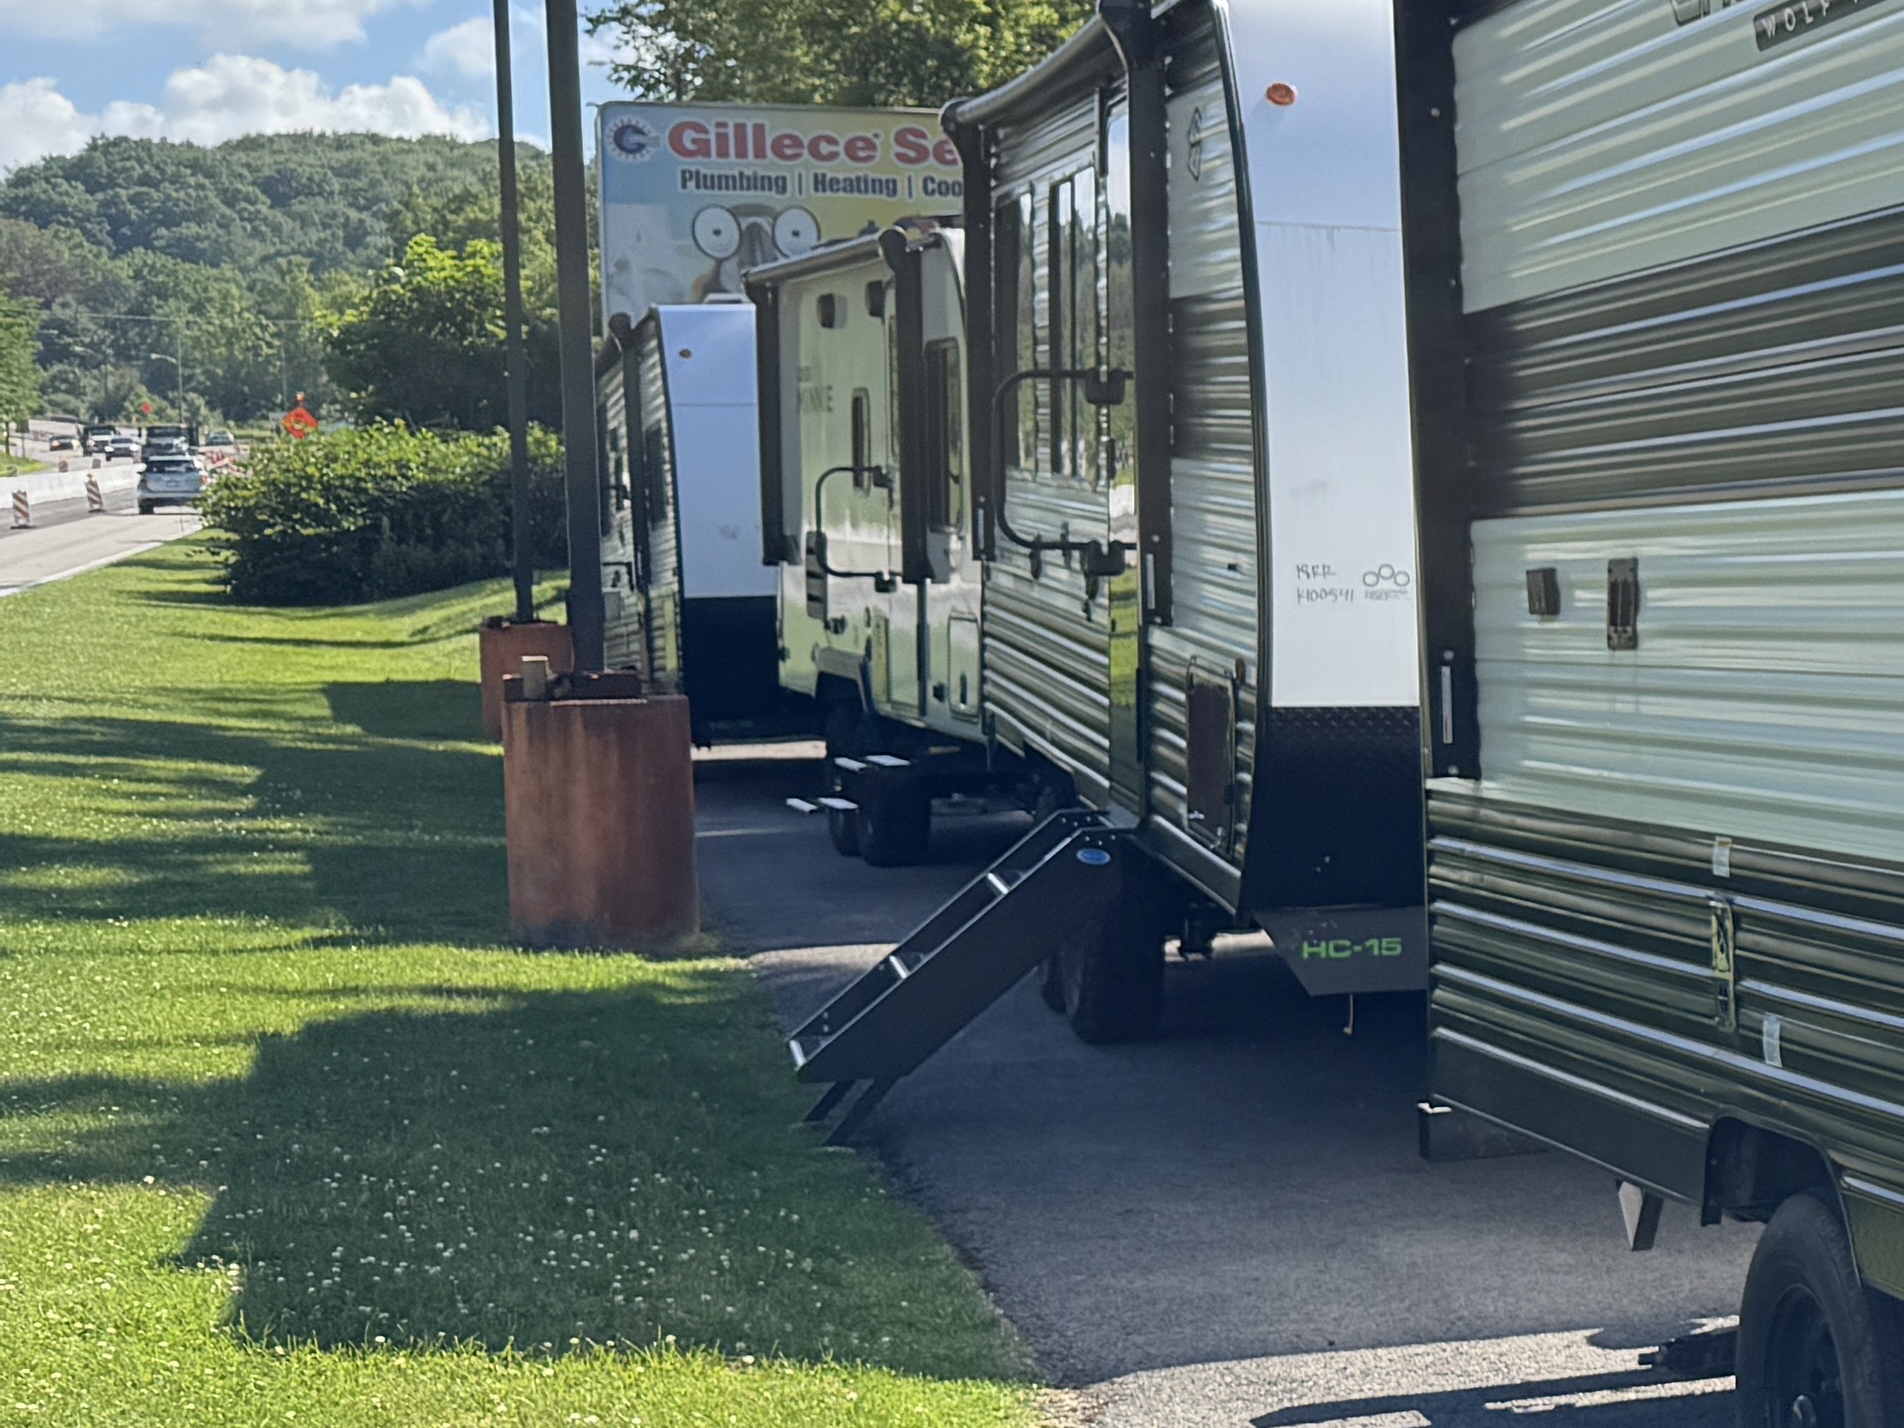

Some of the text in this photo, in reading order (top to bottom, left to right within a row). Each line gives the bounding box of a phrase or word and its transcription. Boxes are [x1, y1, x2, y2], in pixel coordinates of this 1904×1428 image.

[668, 121, 880, 164] Gillece
[680, 169, 788, 196] Plumbing
[813, 172, 898, 198] Heating
[1302, 937, 1402, 960] HC-15
